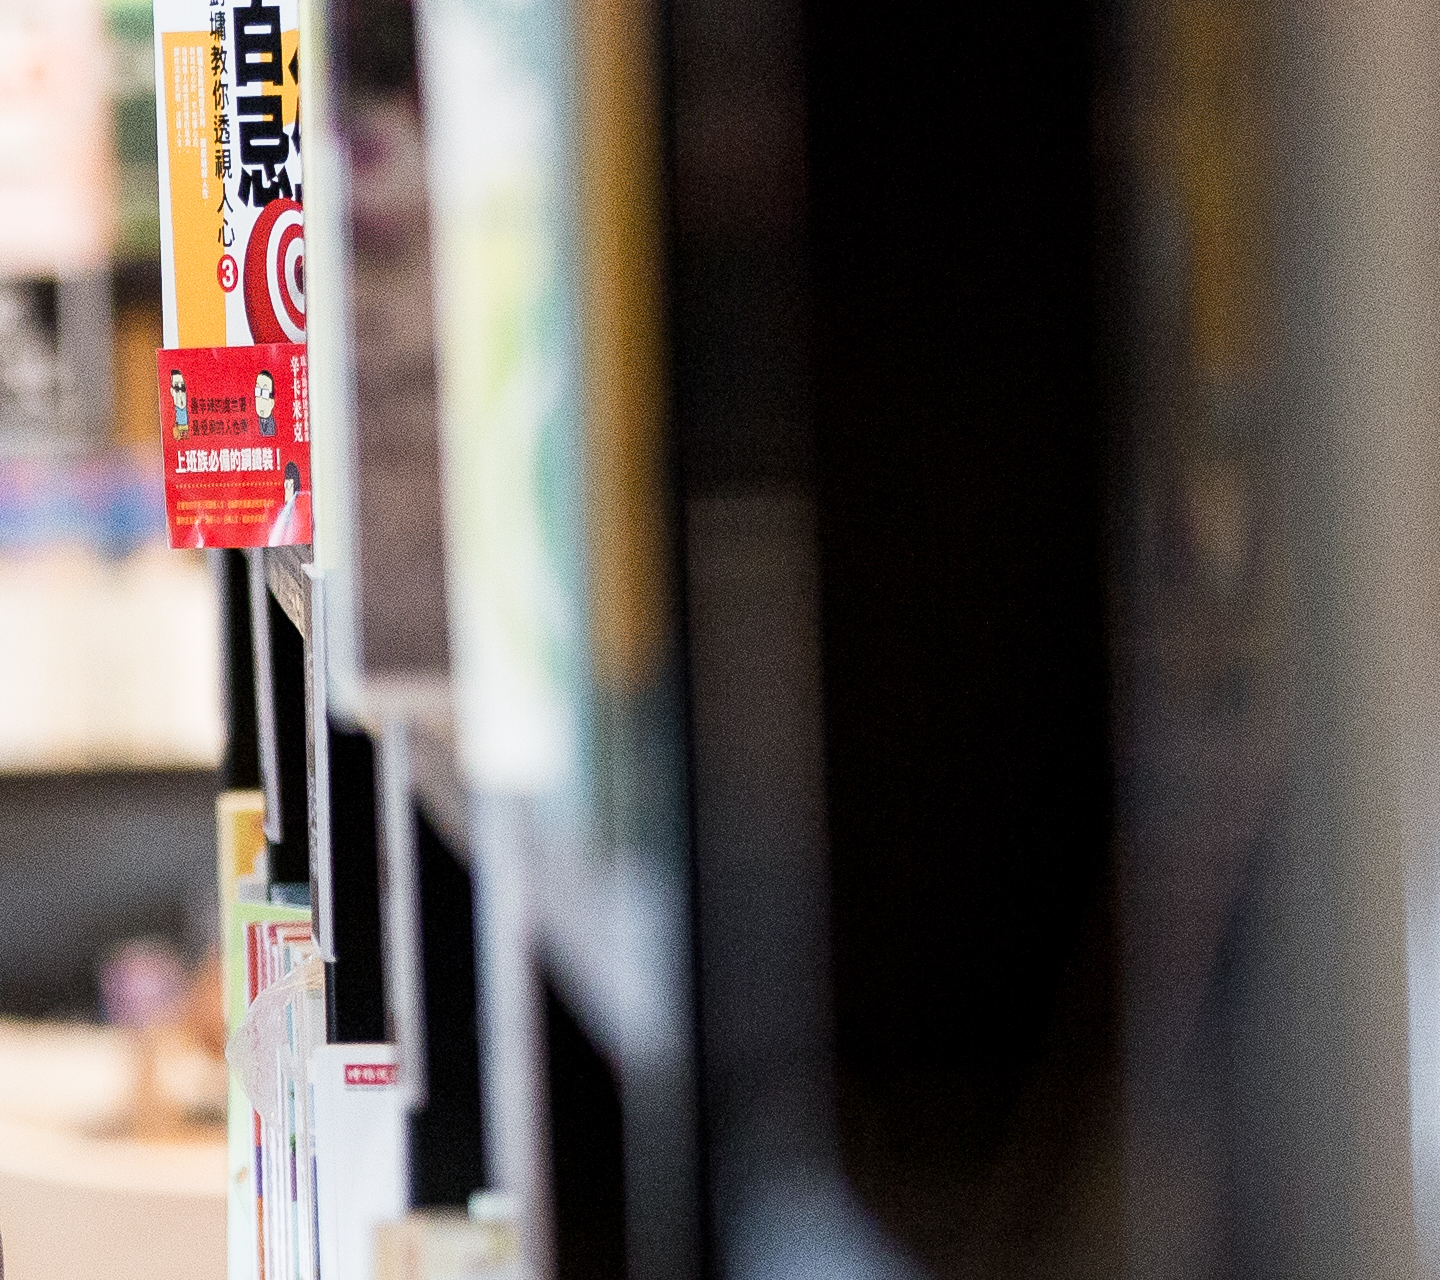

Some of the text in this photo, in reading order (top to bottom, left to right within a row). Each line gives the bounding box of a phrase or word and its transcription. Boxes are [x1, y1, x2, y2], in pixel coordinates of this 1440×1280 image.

[221, 258, 234, 288] 3
[288, 355, 304, 443] 辛卡米克
